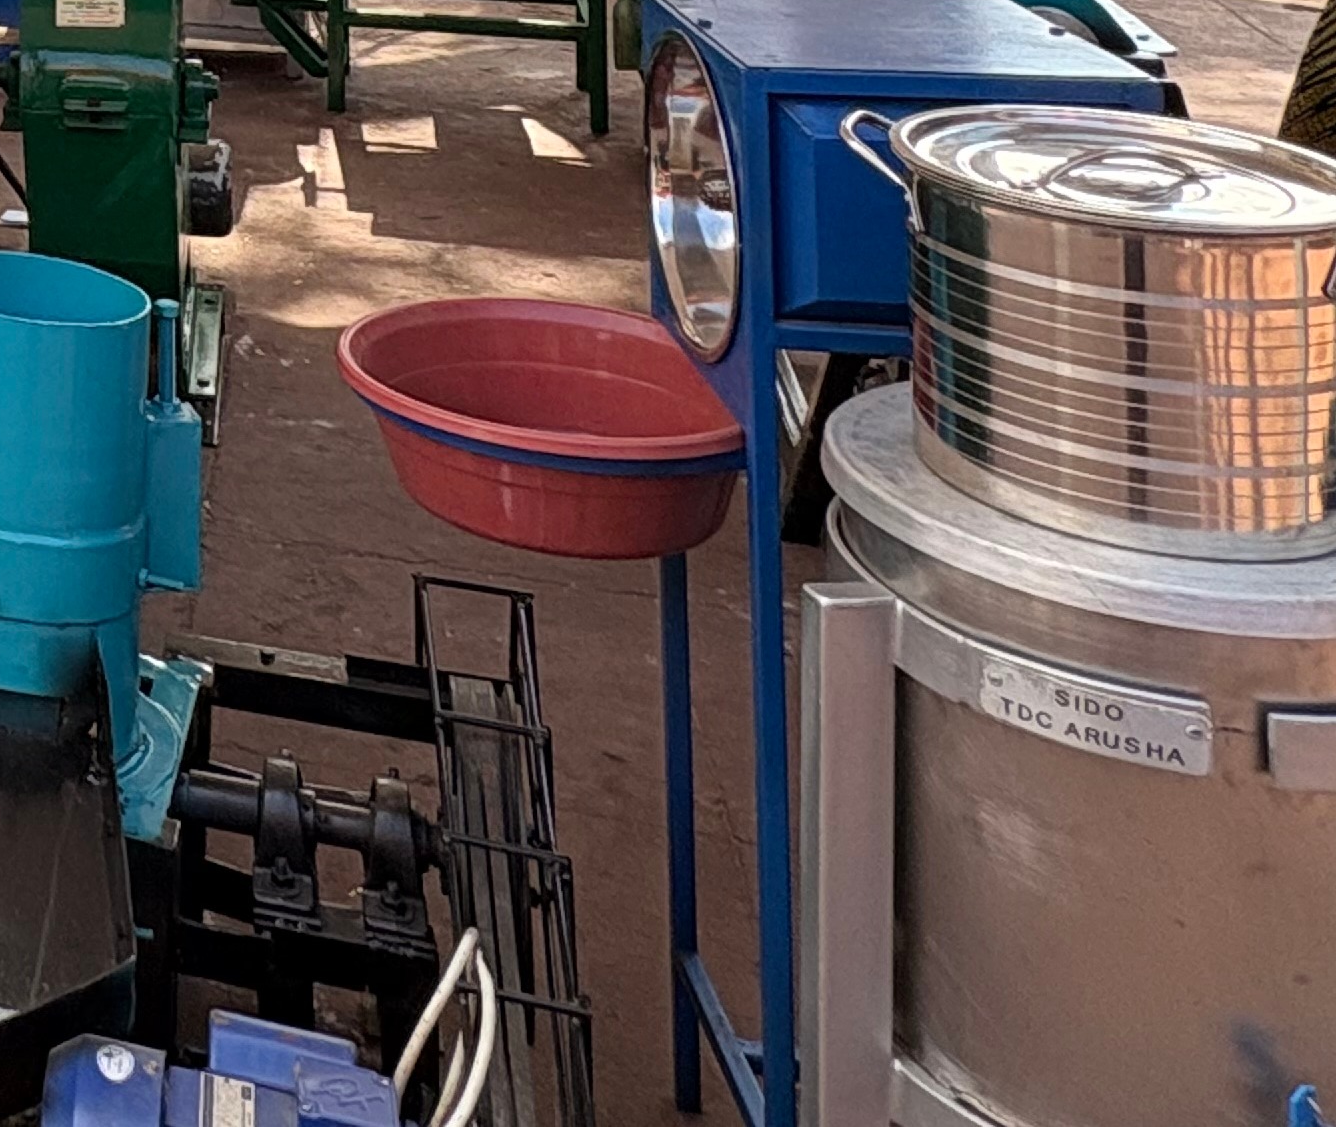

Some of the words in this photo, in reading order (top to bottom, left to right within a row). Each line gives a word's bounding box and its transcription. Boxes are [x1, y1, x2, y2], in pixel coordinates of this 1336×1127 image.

[1000, 695, 1053, 730] TDC
[1064, 721, 1186, 766] ARUSHA
[1054, 688, 1124, 722] SIDO
